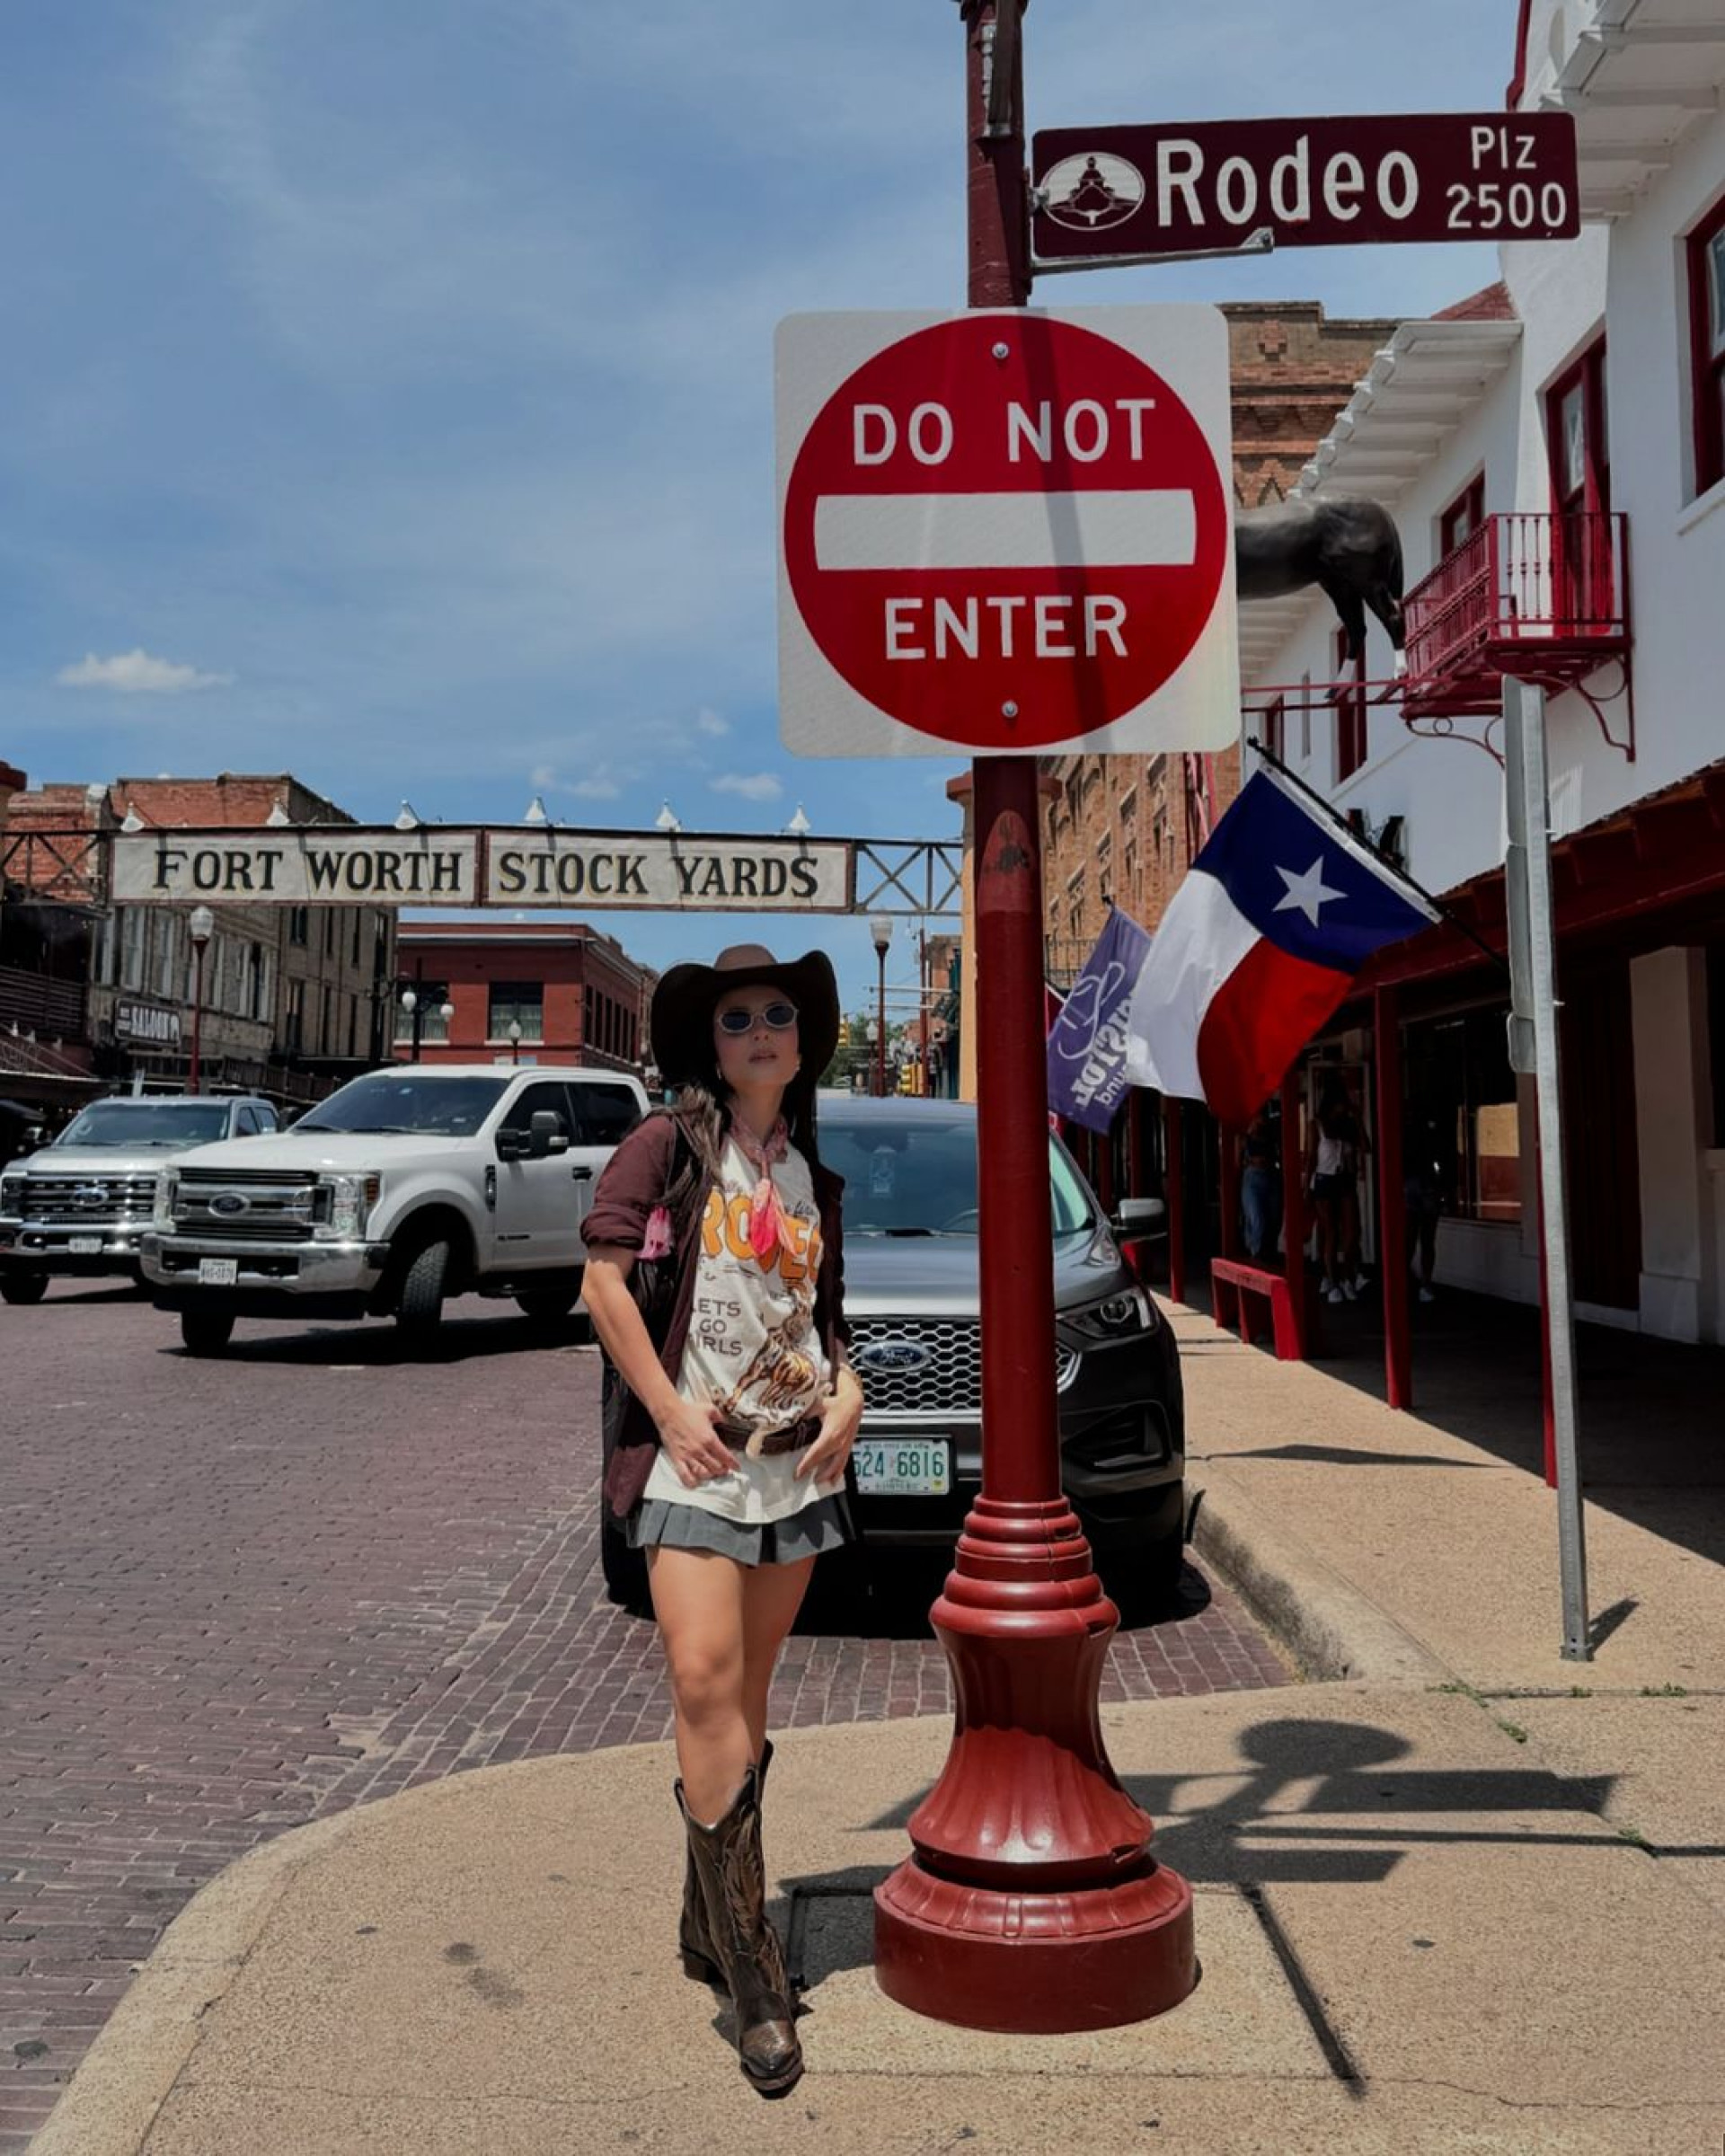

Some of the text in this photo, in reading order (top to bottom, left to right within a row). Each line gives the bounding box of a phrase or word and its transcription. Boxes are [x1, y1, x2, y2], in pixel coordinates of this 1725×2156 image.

[1470, 125, 1536, 171] Plz
[1155, 135, 1420, 228] Rodeo
[1445, 181, 1567, 230] 2500
[853, 399, 1155, 465] DO NOT
[884, 595, 1128, 660] ENTER
[152, 850, 819, 899] FORT WORTH STOCK YARDS
[691, 1297, 742, 1318] ETS
[700, 1318, 727, 1334] GO
[898, 1451, 944, 1478] 6816
